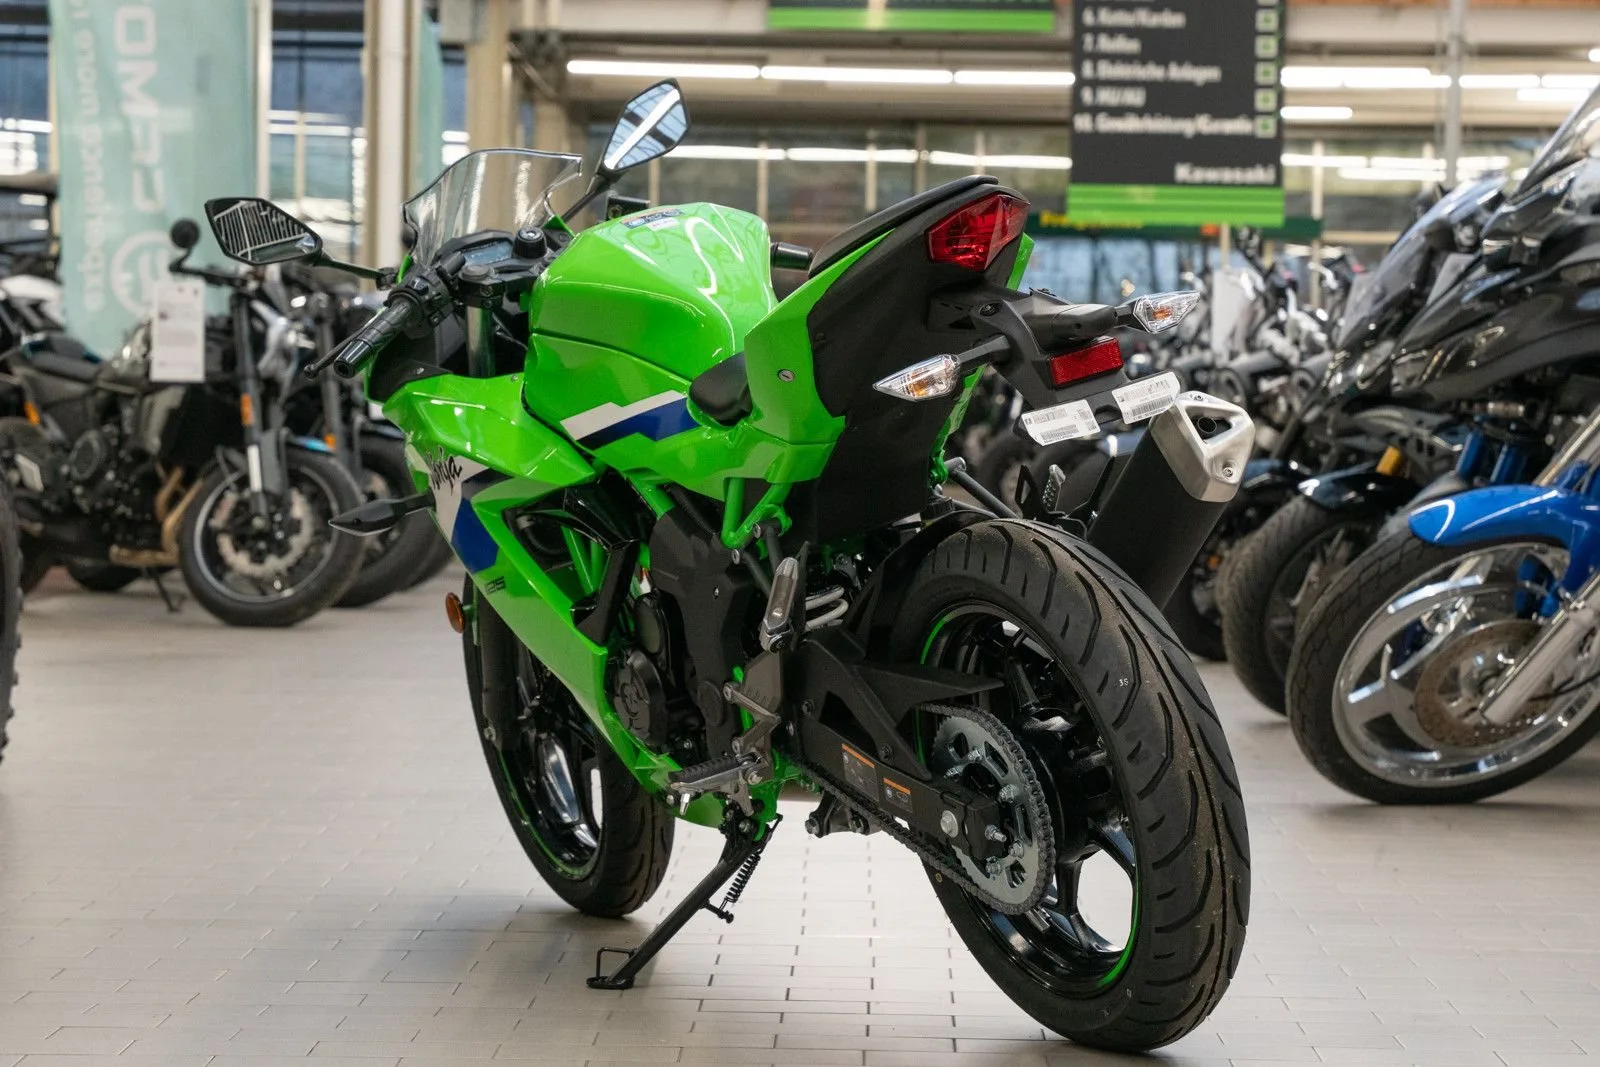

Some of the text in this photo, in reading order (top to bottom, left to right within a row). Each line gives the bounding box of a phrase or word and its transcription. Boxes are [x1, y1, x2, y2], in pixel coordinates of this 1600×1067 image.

[1096, 33, 1142, 54] Reifen
[1096, 59, 1165, 81] Elektrische
[1168, 61, 1222, 86] Anlagen
[1174, 162, 1275, 184] Kawasaki
[427, 447, 463, 494] Ninja
